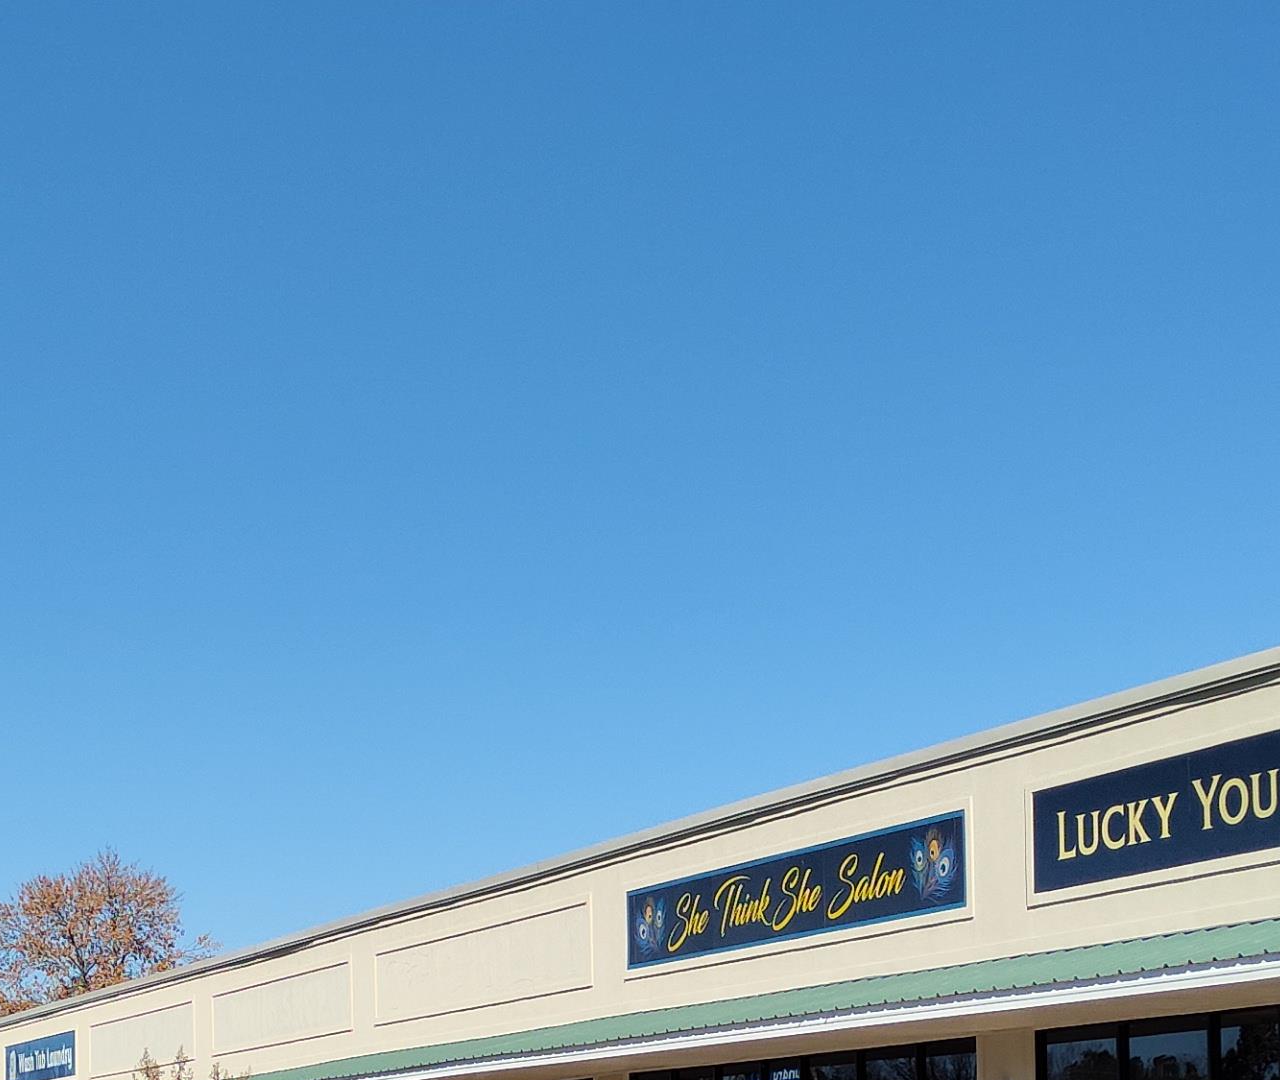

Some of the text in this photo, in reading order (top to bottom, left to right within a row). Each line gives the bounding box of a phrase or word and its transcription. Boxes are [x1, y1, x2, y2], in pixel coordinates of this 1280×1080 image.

[1057, 768, 1280, 862] LUCKY YOU
[667, 852, 906, 953] She Think She Salon
[18, 1044, 72, 1074] Wash Tub Laundry
